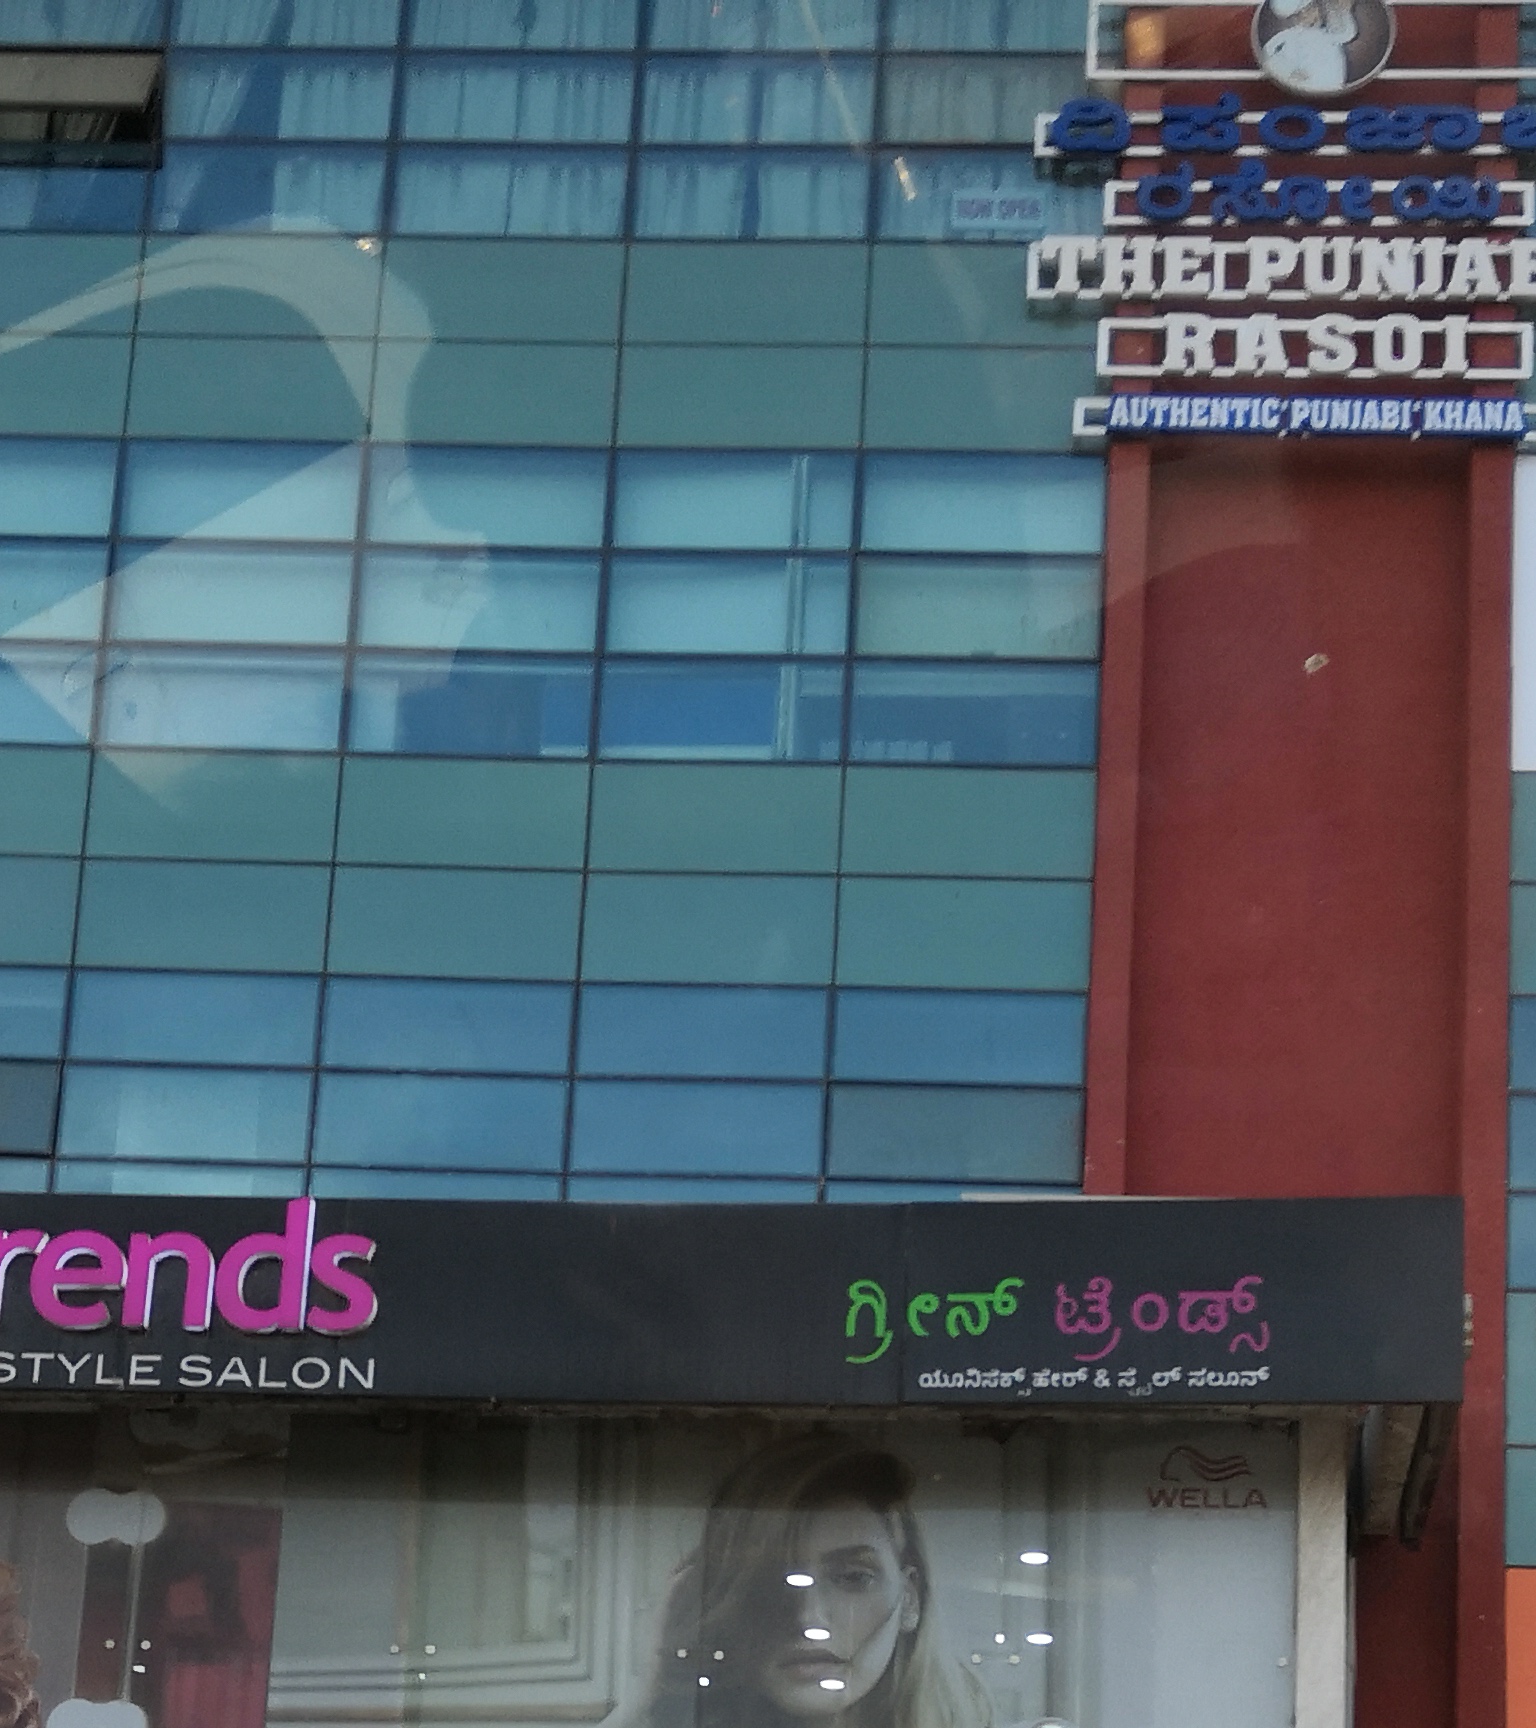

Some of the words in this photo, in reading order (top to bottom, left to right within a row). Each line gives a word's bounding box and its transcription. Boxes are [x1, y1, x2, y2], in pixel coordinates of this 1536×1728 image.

[1040, 234, 1214, 299] THE
[1162, 311, 1470, 378] RASOI
[1422, 400, 1526, 434] KHANA
[177, 1355, 376, 1391] SALON
[1145, 1487, 1268, 1509] WELLA
